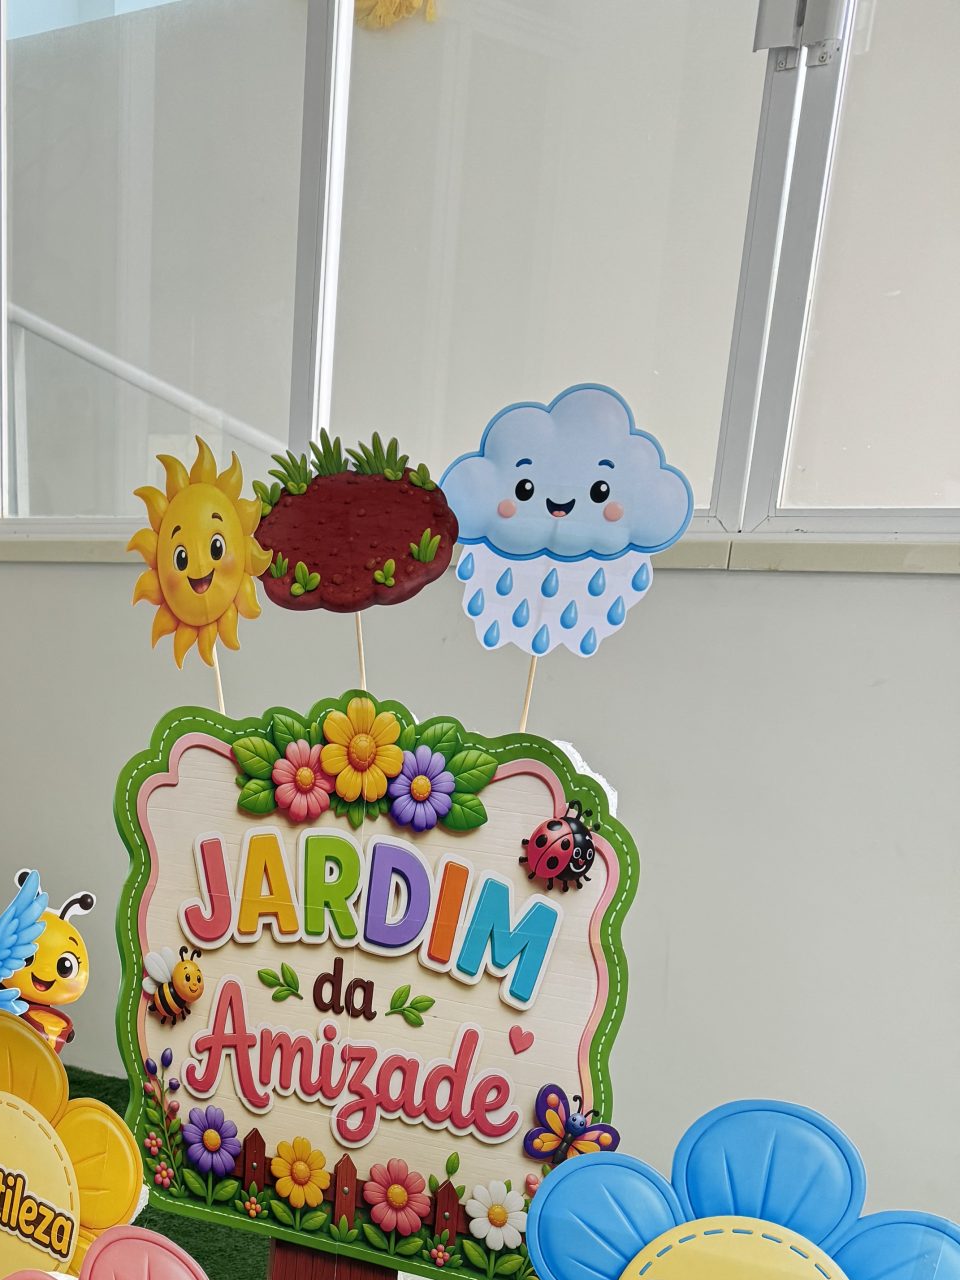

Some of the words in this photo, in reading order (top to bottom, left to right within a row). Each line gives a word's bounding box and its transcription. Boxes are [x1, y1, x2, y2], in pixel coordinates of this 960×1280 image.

[181, 829, 560, 1006] JARDIM
[312, 956, 377, 1021] da
[184, 978, 521, 1144] Amizade
